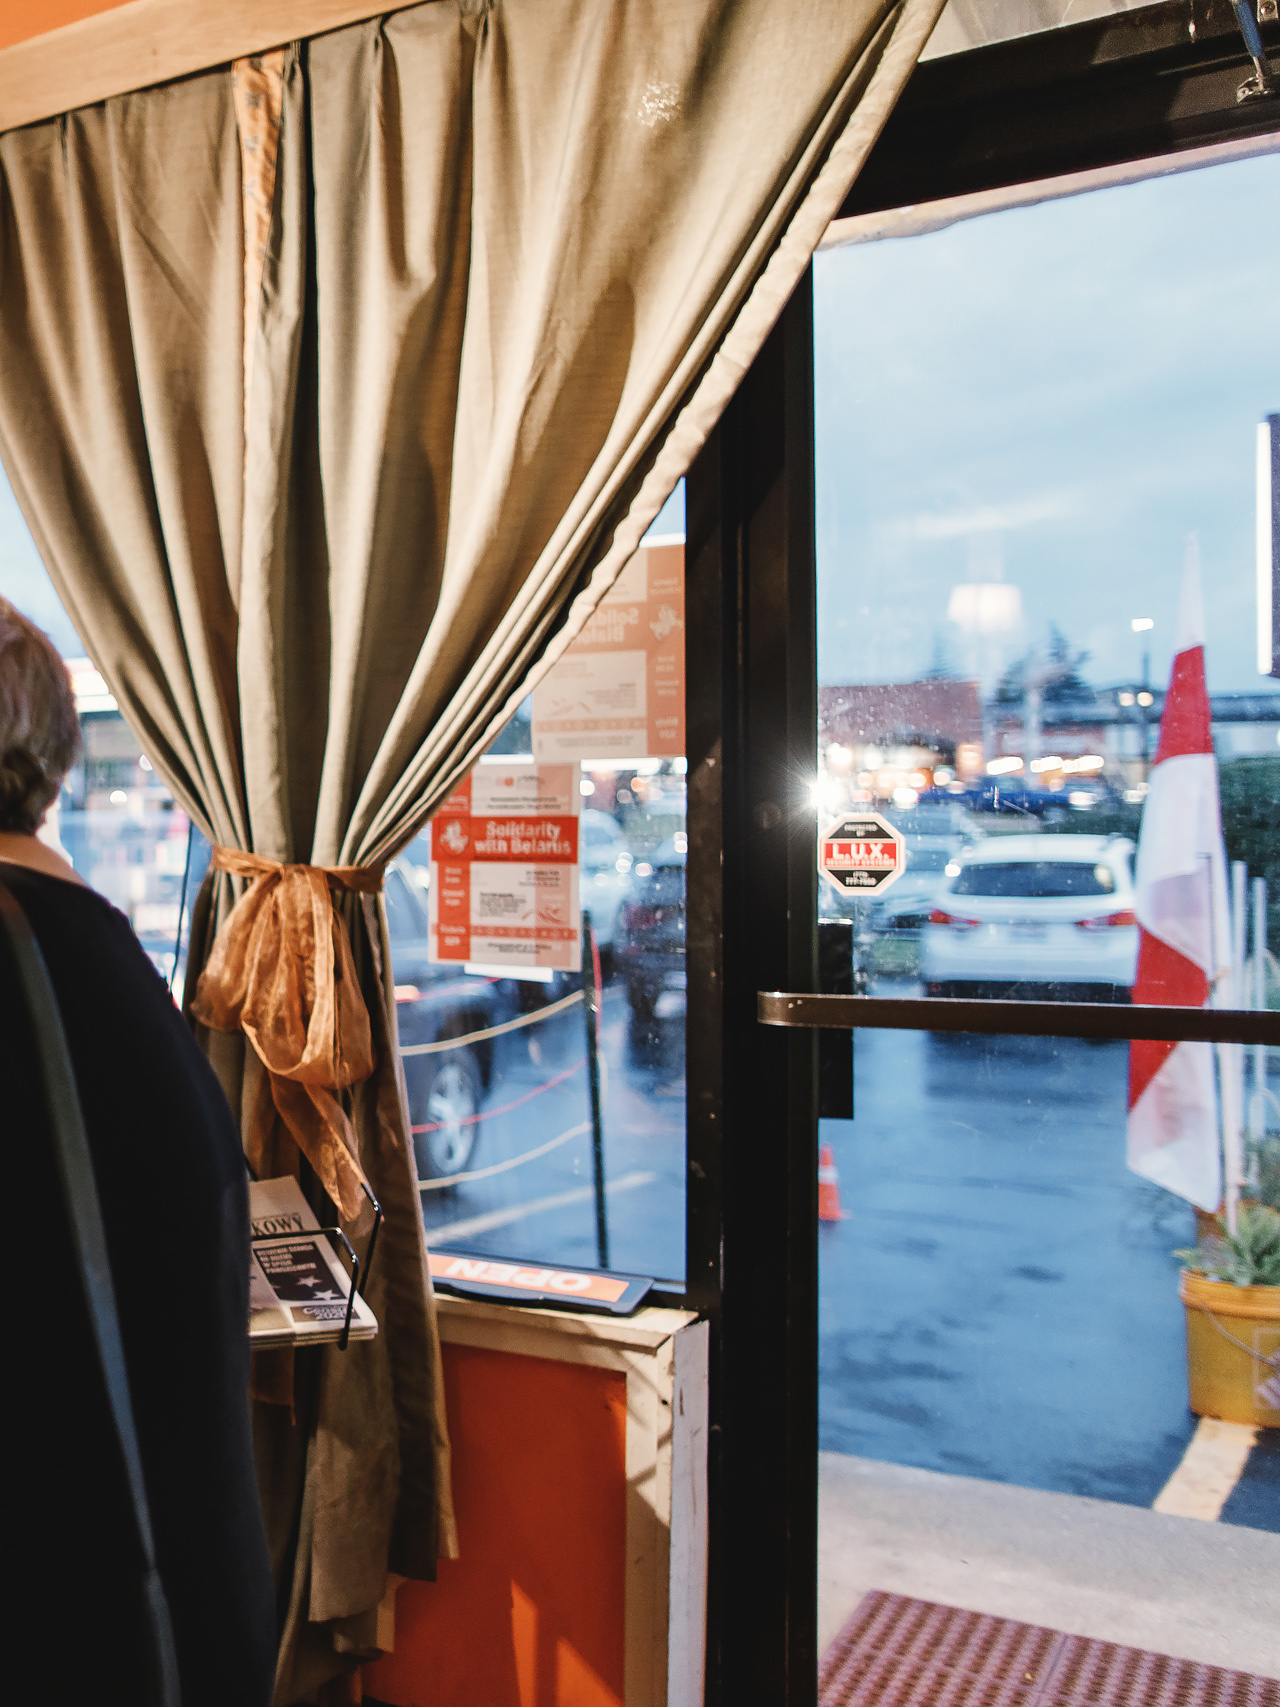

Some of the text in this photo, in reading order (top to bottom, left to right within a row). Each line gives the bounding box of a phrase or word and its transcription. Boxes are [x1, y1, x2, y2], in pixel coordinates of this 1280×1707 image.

[486, 820, 561, 838] Solidarity
[474, 838, 571, 854] with Belarus
[832, 843, 890, 859] L.U.X.
[445, 1259, 591, 1292] OPEN
